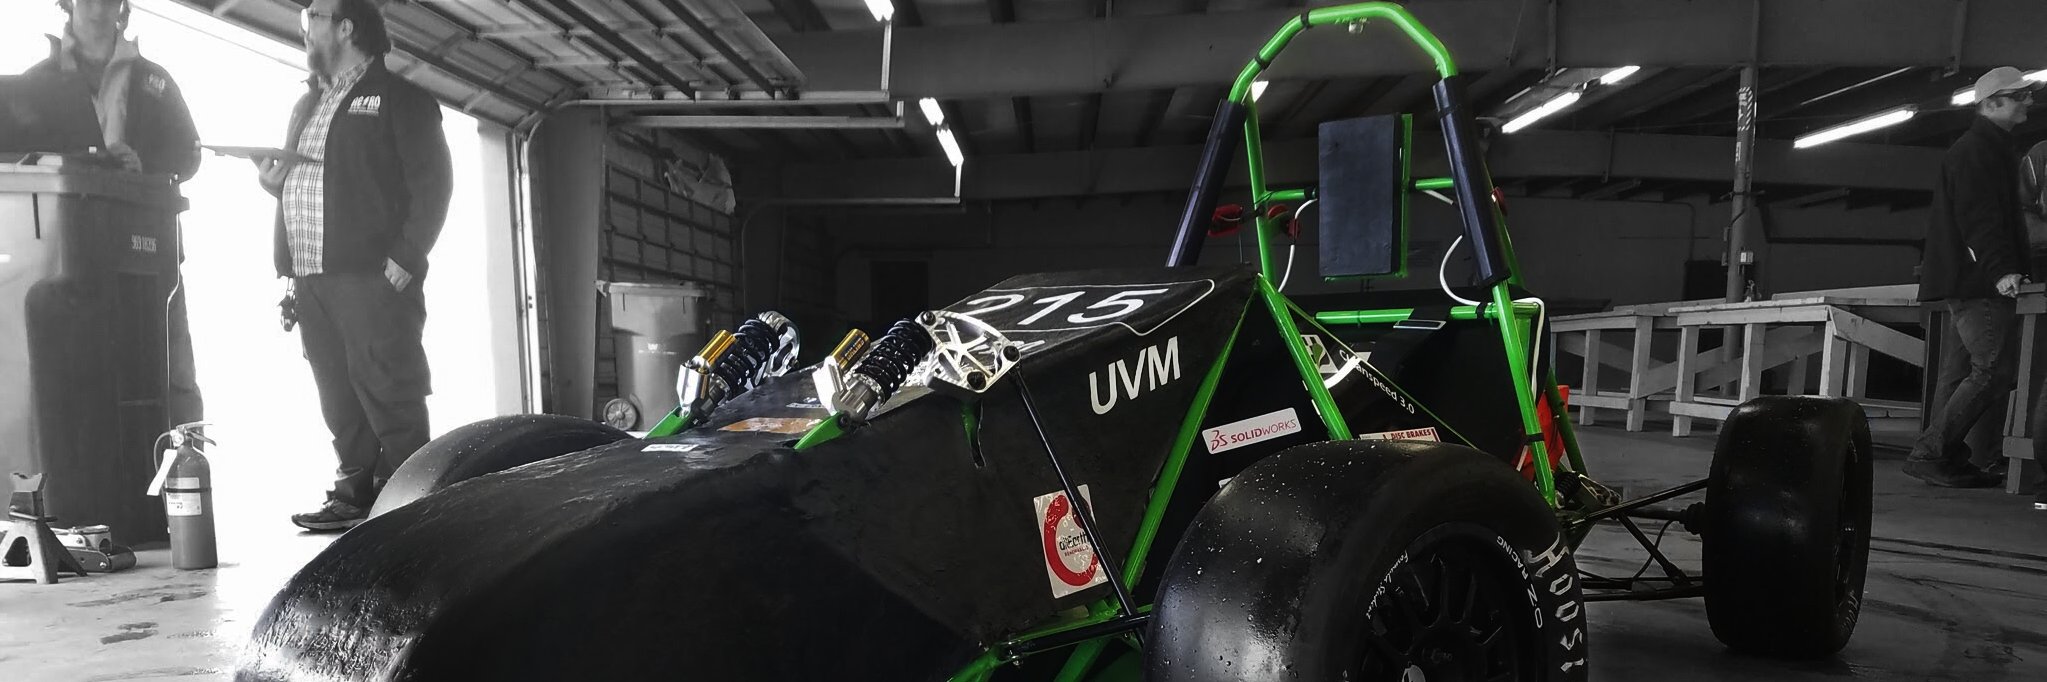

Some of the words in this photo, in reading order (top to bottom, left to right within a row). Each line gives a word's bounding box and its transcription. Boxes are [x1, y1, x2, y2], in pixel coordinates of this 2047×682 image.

[1088, 336, 1181, 415] UVM
[1399, 396, 1415, 415] 3.0
[1231, 418, 1297, 443] SOLIDWORKS
[1406, 428, 1431, 438] BRAKES
[1496, 535, 1529, 580] RACING
